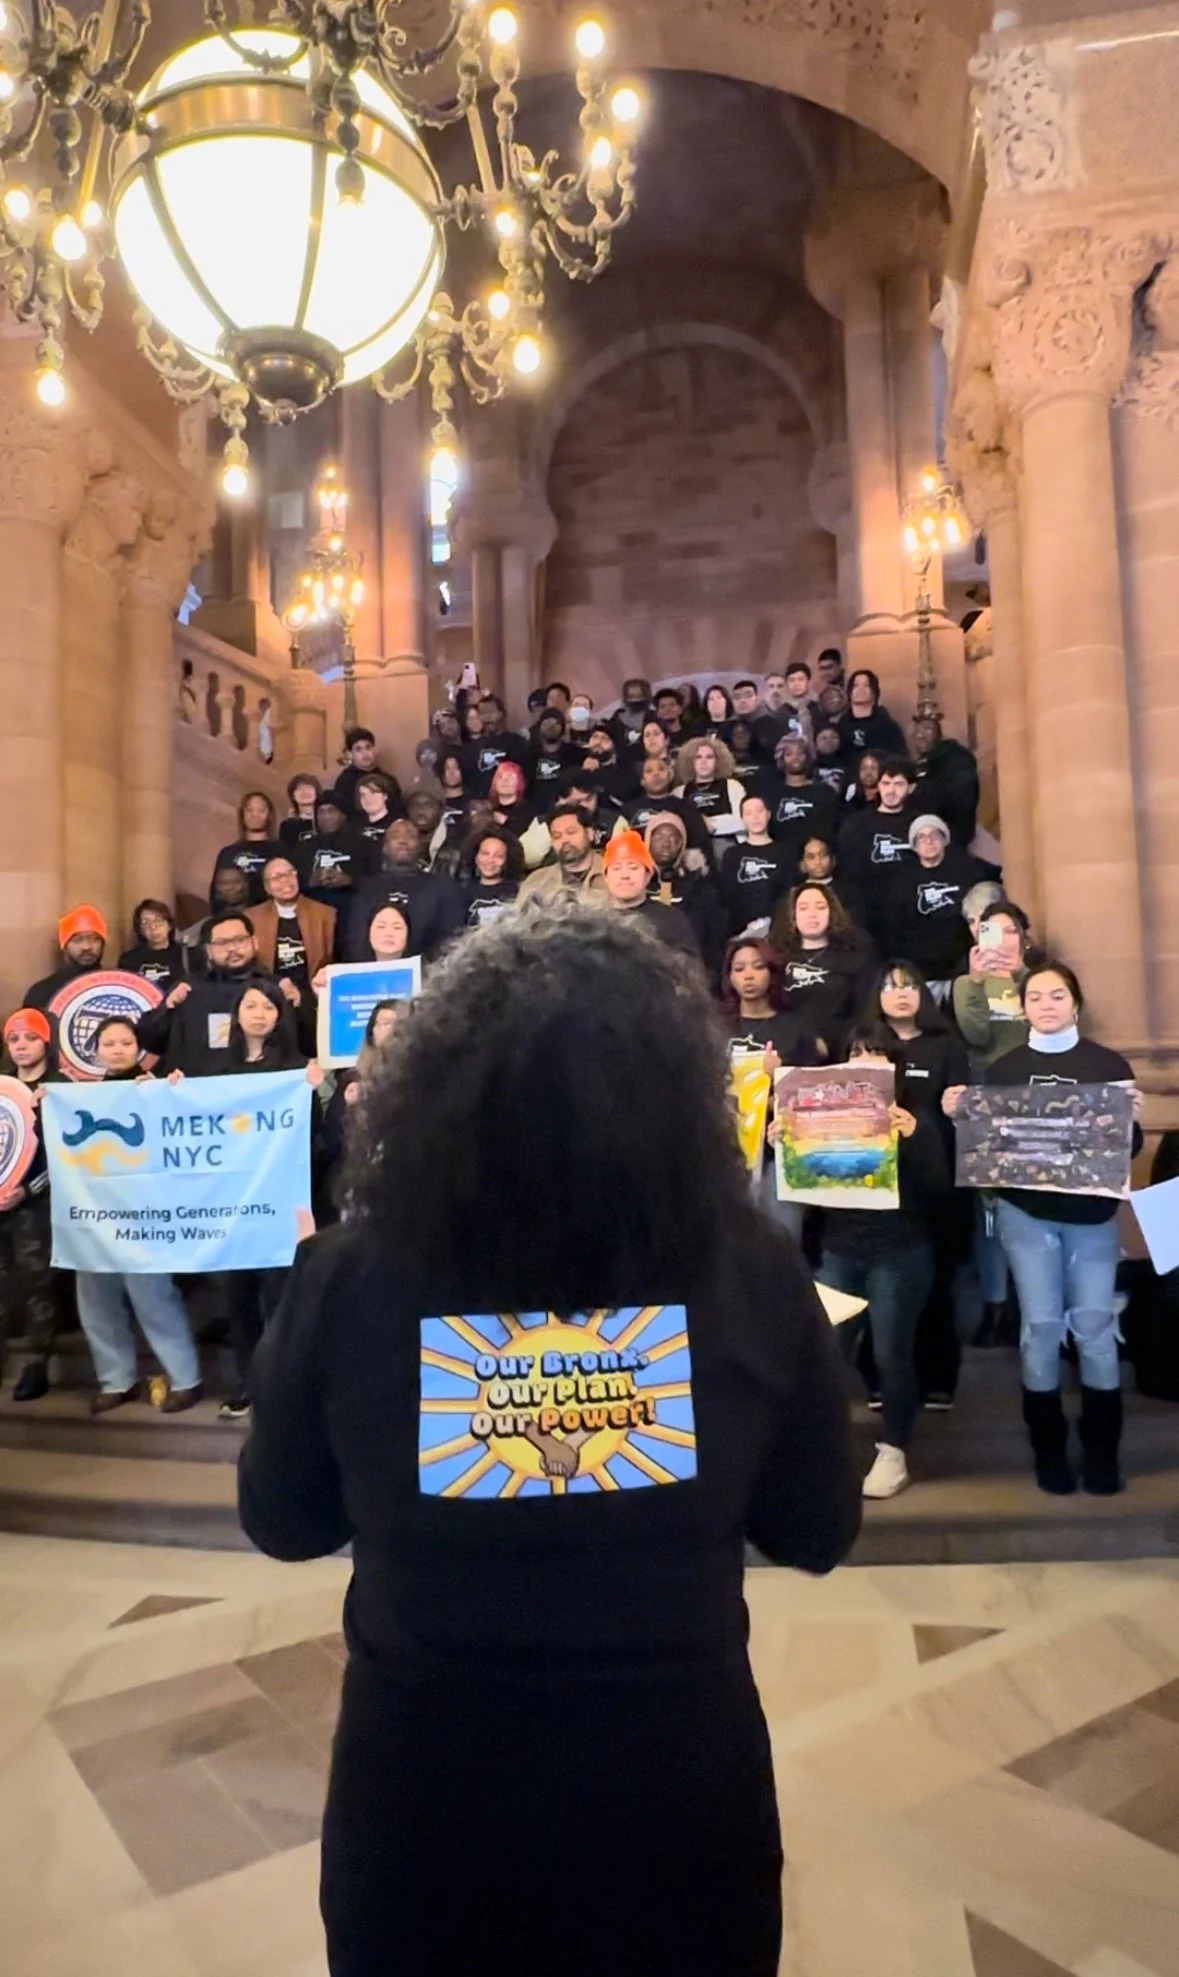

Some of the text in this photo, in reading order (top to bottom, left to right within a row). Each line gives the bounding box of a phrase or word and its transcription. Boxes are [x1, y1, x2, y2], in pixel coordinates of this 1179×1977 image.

[163, 1145, 222, 1168] NYC
[69, 1203, 276, 1223] Empowering Generatons,
[115, 1227, 227, 1244] Making Waves
[475, 1353, 535, 1380] Our
[488, 1382, 548, 1409] Our
[470, 1397, 656, 1439] Our Power!
